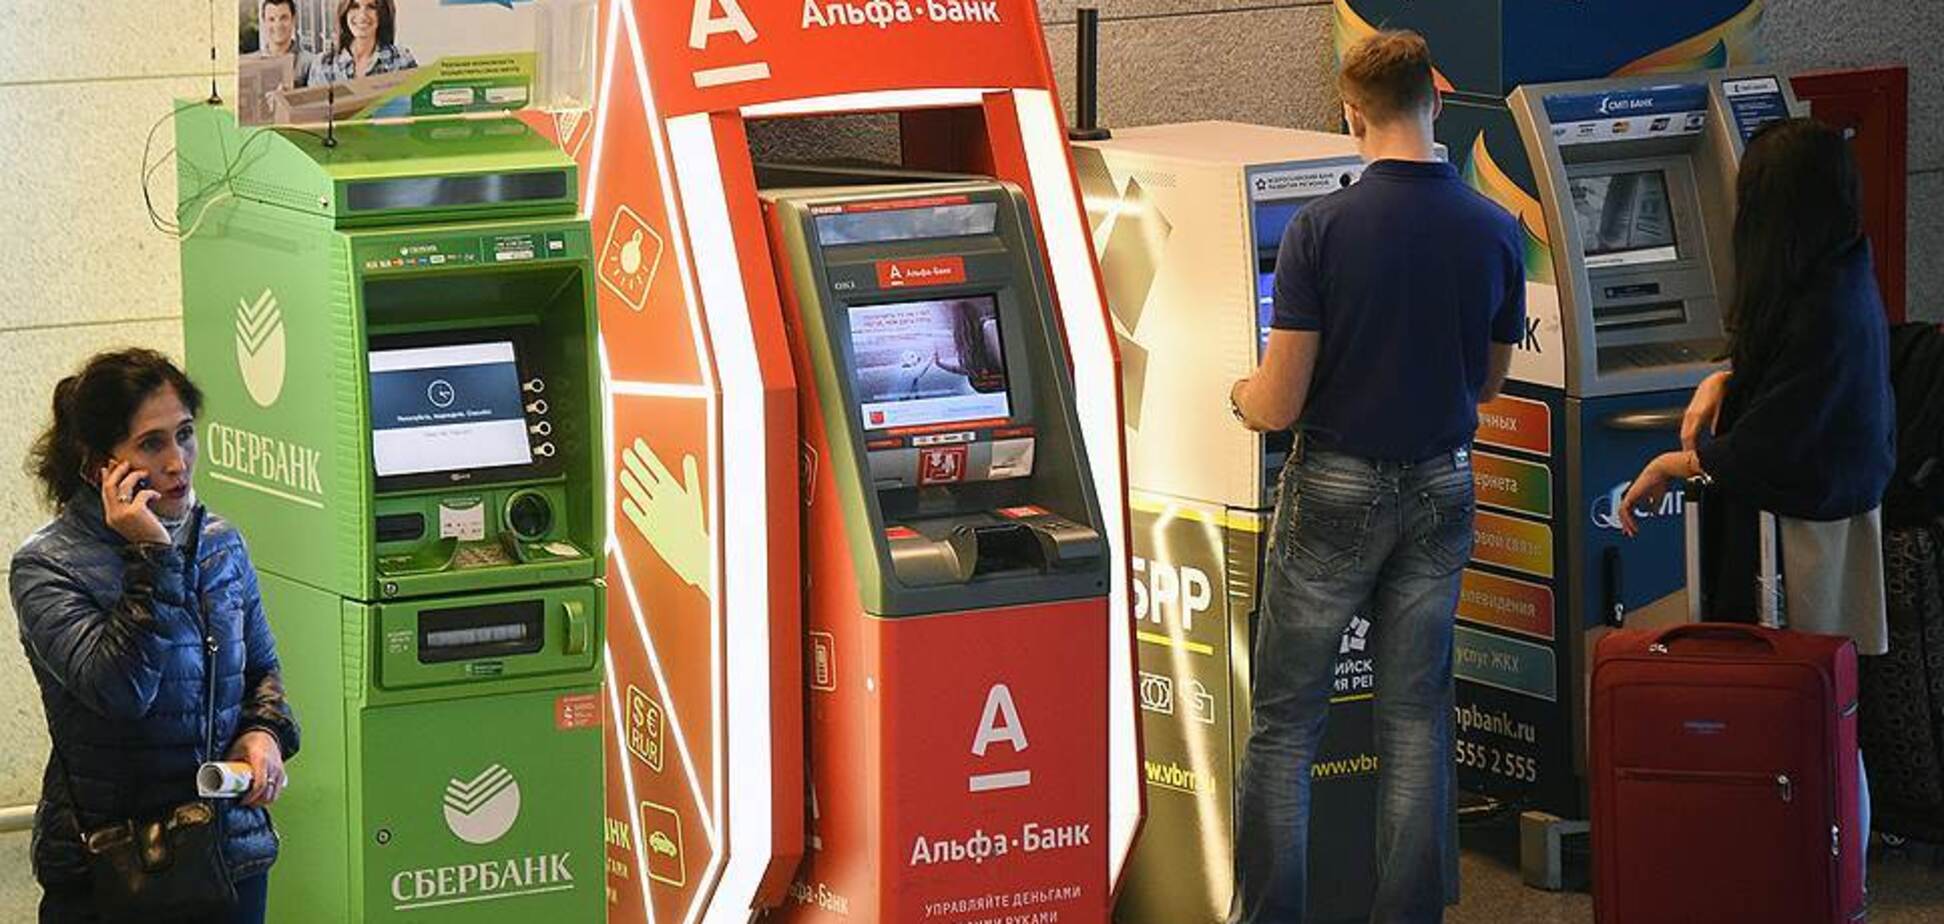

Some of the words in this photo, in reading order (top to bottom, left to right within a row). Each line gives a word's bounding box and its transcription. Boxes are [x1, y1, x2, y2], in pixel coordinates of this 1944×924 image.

[207, 422, 323, 495] СБЕРБАНК
[1456, 740, 1487, 769] 555
[1491, 749, 1502, 774] 2
[1505, 752, 1536, 783] 555
[391, 852, 574, 901] СБЕРБАНК
[925, 895, 1010, 918] УПРАВЛЯЙТЕ
[1012, 885, 1082, 911] ДЕНЬГАМИ
